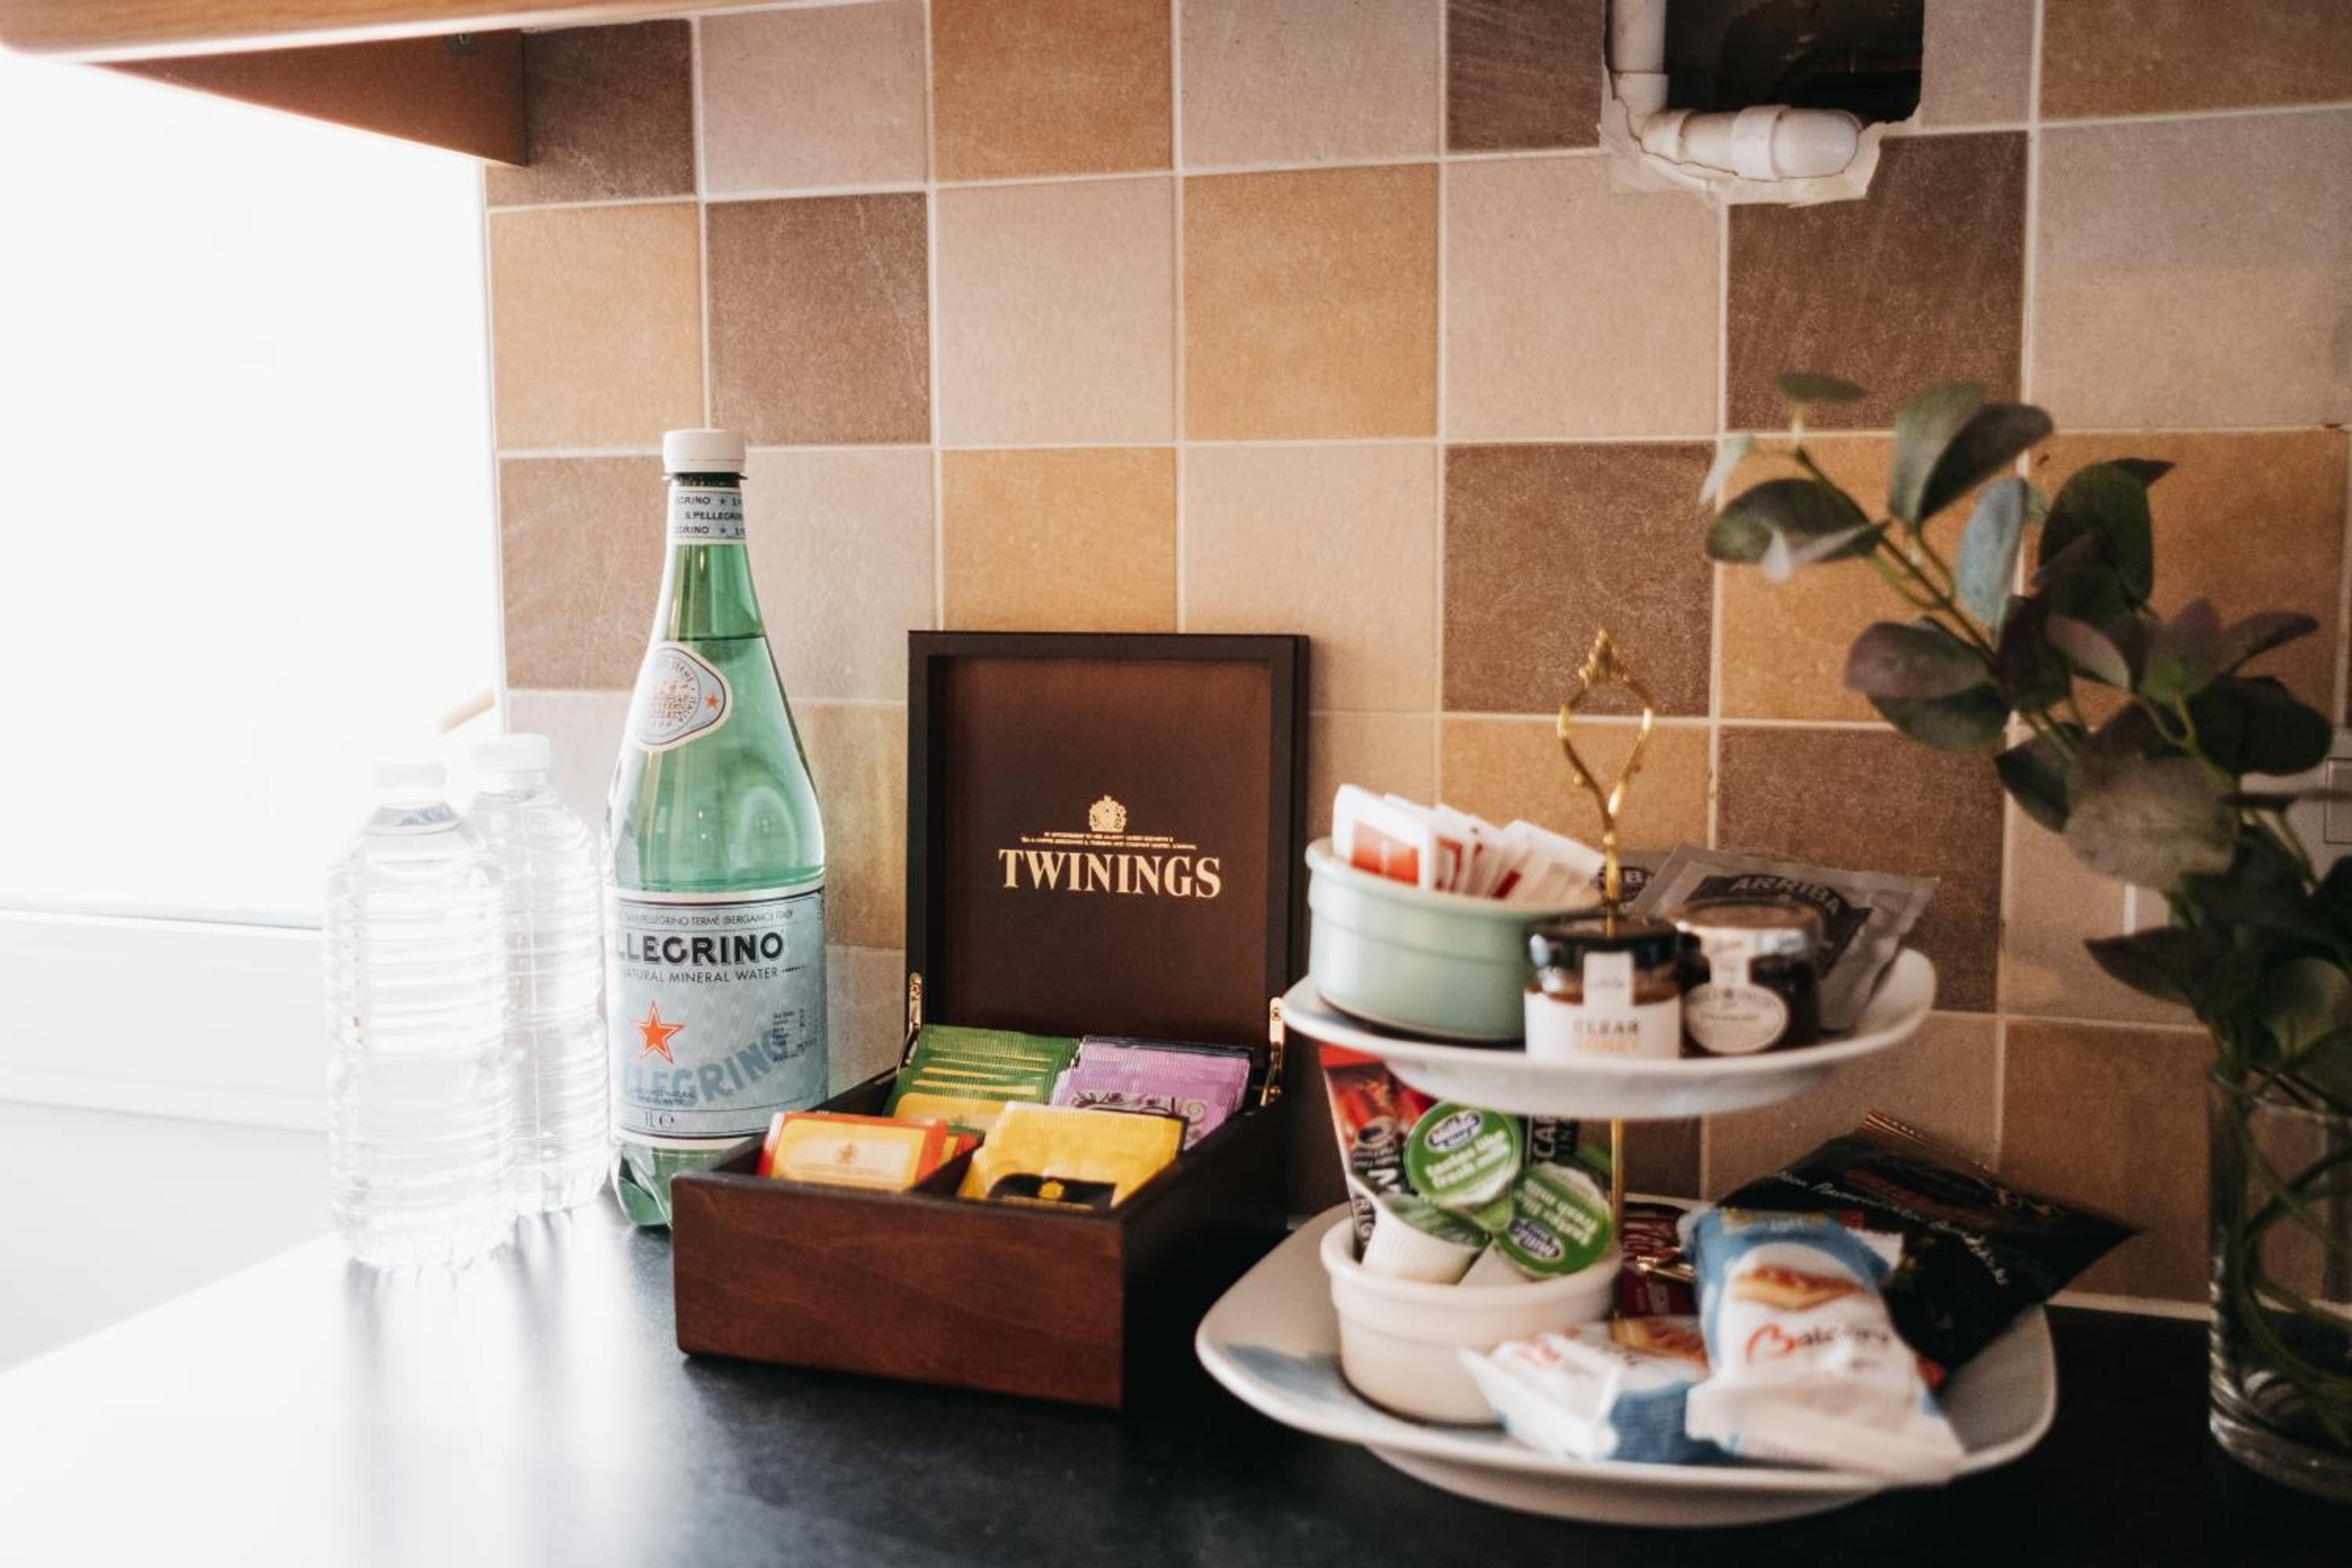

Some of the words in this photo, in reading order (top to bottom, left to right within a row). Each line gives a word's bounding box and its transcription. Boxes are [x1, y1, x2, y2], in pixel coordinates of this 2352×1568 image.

[999, 849, 1221, 898] TWININGS
[1730, 876, 1841, 916] ARRIBA
[669, 971, 730, 984] MINERAL
[735, 967, 779, 981] WATER
